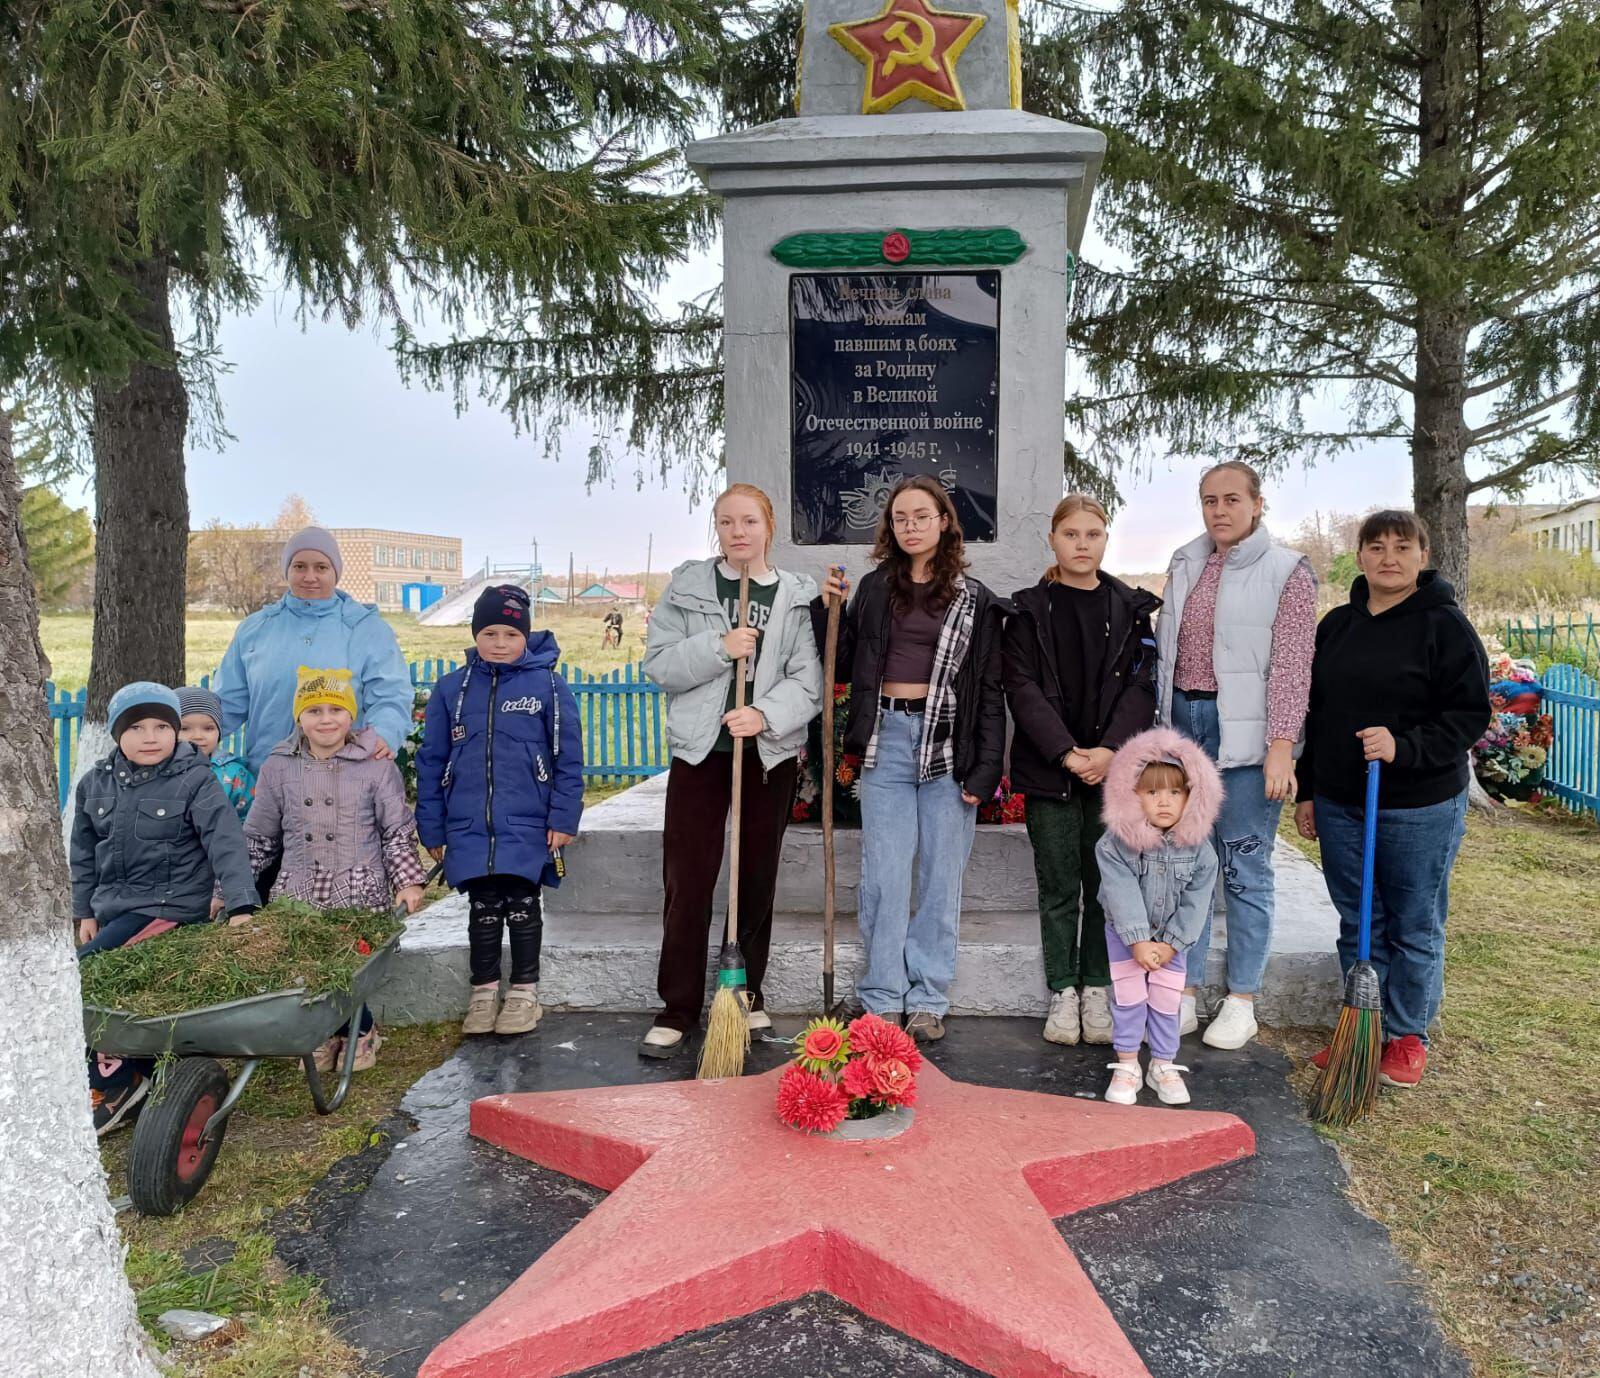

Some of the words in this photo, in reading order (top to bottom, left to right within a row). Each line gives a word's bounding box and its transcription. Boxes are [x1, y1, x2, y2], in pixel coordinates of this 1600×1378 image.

[908, 287, 953, 300] слава
[864, 312, 927, 326] воинам
[834, 338, 902, 352] павшим
[905, 338, 917, 351] в
[918, 333, 957, 351] боях
[854, 364, 873, 378] за
[876, 360, 937, 380] Родину
[853, 389, 863, 403] в
[867, 384, 938, 404] Великой
[805, 412, 930, 431] Отечественной
[933, 411, 983, 430] войне
[929, 442, 942, 455] г.
